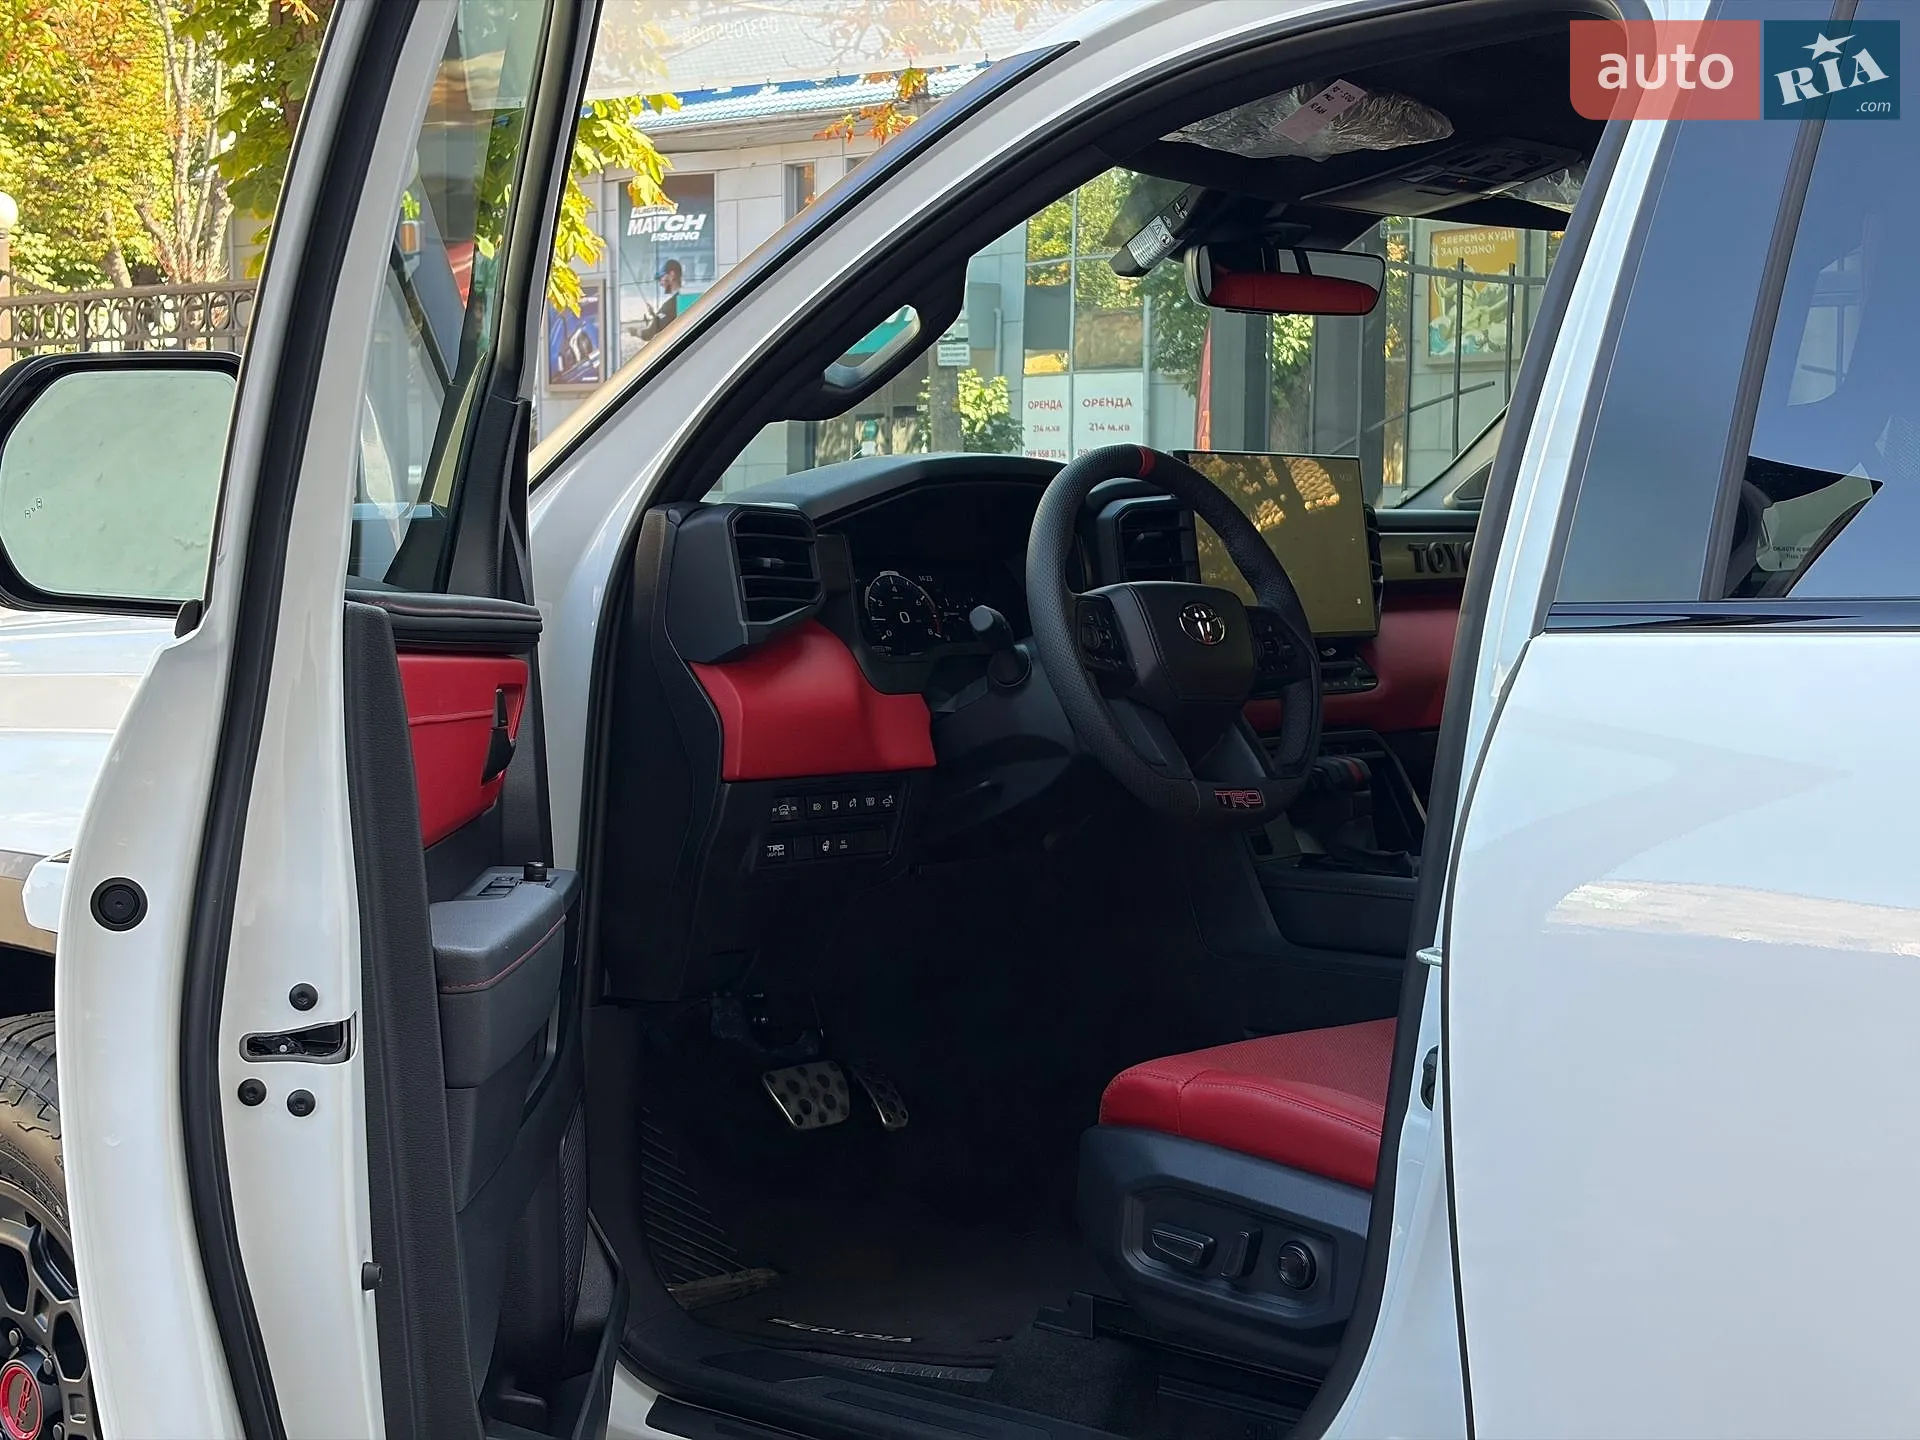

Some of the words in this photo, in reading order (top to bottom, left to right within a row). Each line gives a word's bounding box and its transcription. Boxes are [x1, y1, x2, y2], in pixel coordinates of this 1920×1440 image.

[627, 213, 707, 236] MATCH
[1027, 399, 1063, 411] ОРЕНДА
[1082, 397, 1133, 409] ОРЕНДА
[1089, 422, 1105, 432] 214
[899, 611, 911, 624] 0
